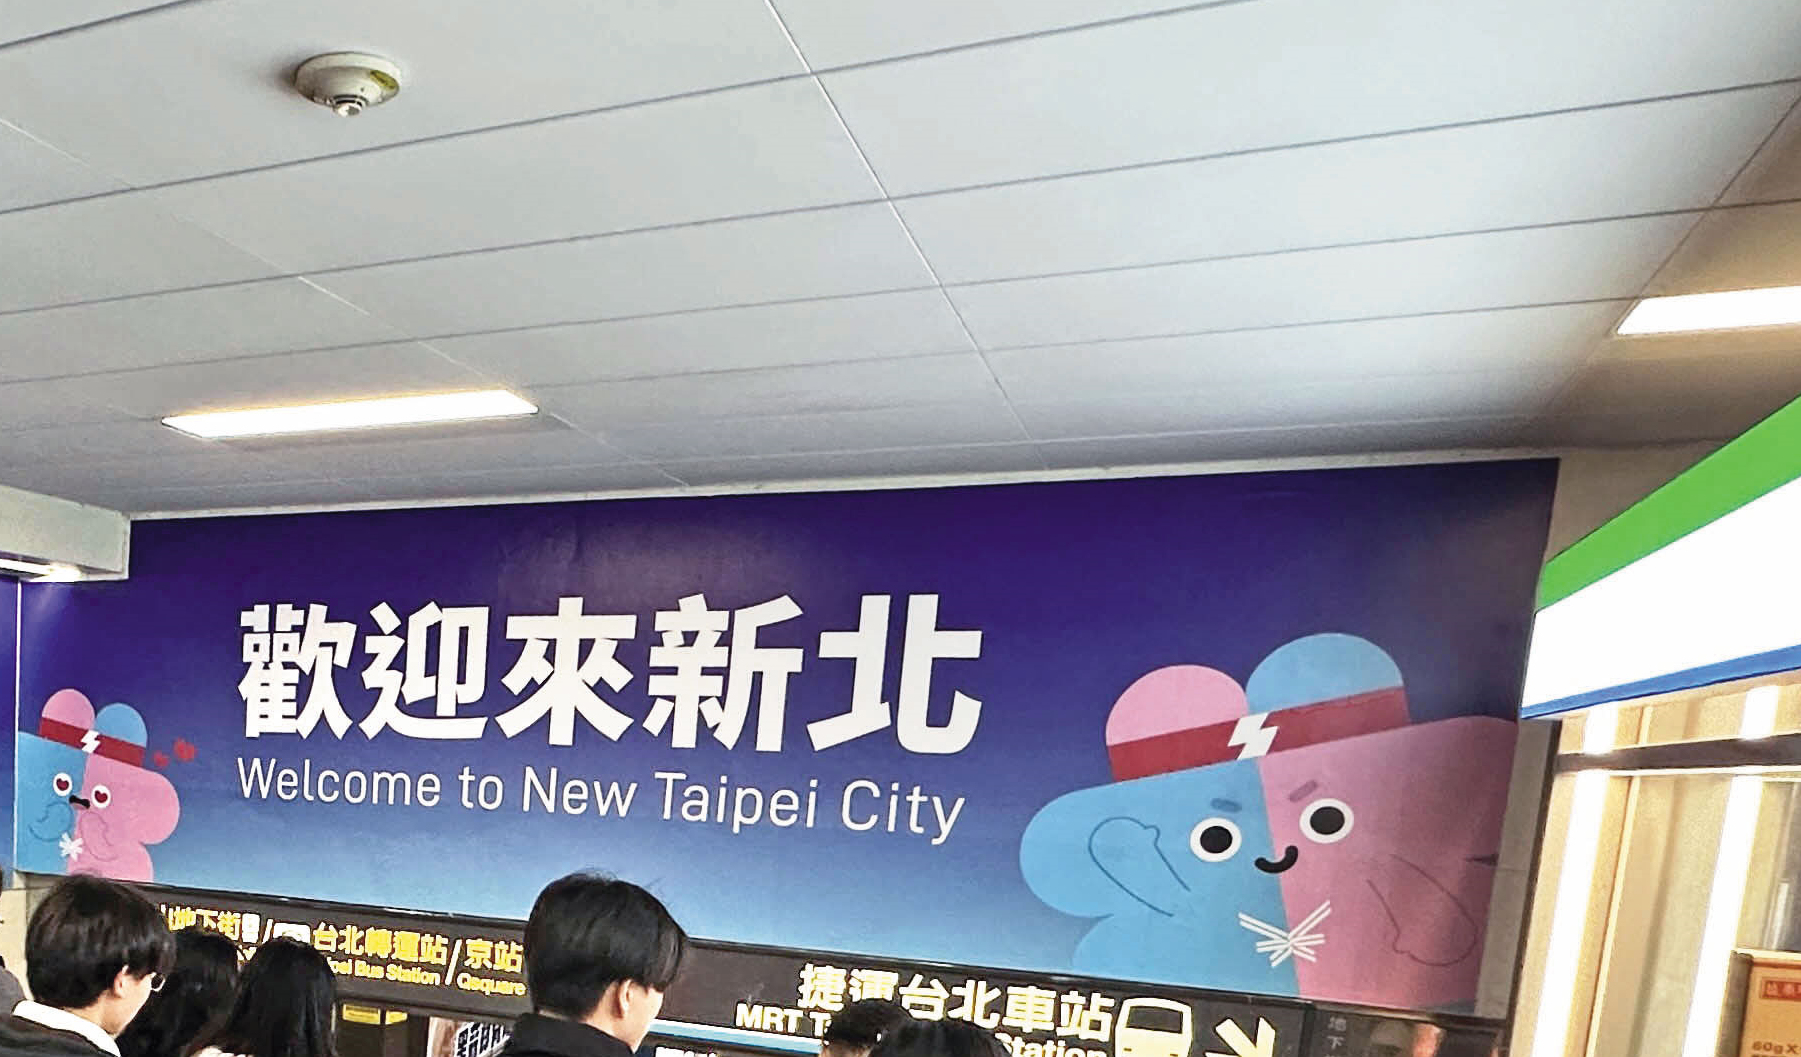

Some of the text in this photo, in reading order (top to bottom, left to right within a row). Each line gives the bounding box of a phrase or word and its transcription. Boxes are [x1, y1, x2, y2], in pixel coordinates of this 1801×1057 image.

[237, 593, 983, 754] 歡迎來新北
[237, 757, 966, 845] Welcome to New Taipei City
[161, 904, 241, 941] 地下街
[354, 960, 384, 979] Bus
[386, 963, 440, 986] Station
[798, 962, 1115, 1042] 捷運台北車站
[735, 1003, 803, 1035] MRT
